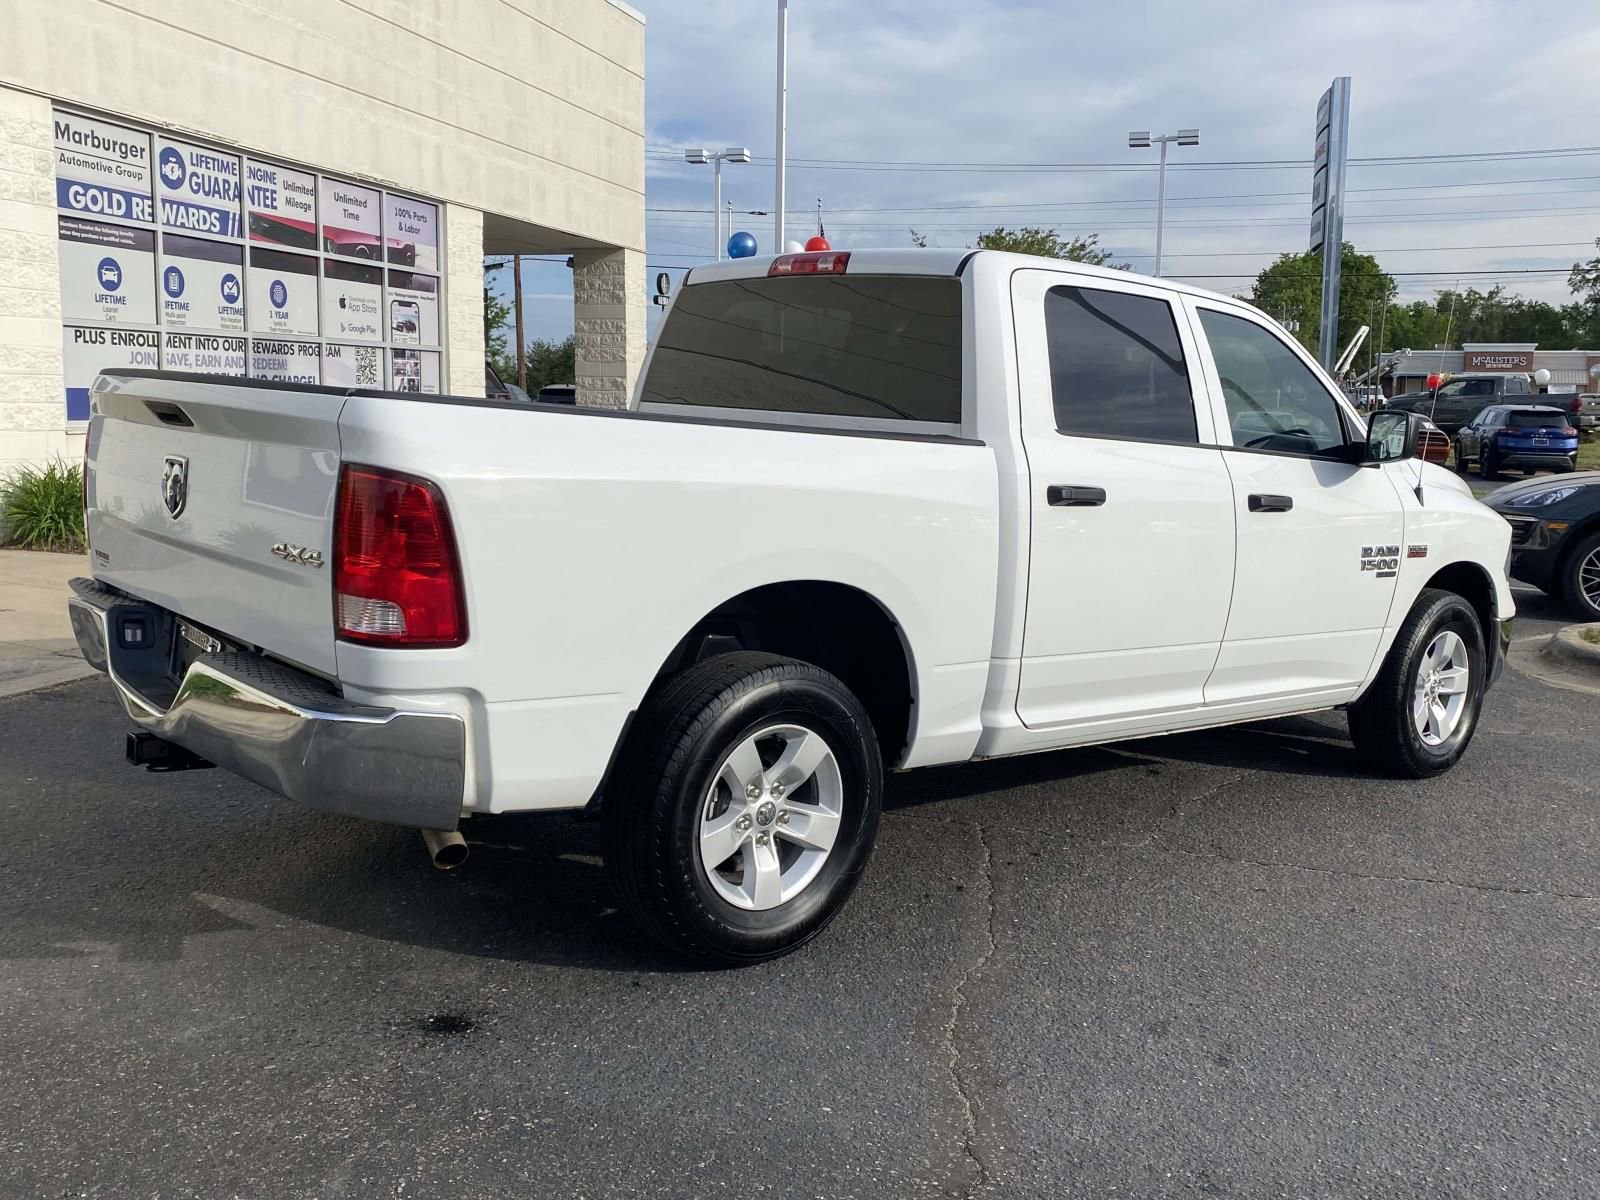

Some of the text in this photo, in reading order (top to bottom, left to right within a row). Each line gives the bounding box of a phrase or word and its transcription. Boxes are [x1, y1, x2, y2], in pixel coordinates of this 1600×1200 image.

[55, 121, 145, 160] Marburger
[59, 152, 143, 181] Automotive Group
[190, 152, 237, 176] LIFETIME
[283, 180, 314, 197] Unlimited
[68, 185, 126, 217] GOLD
[285, 198, 311, 212] Mileage
[334, 192, 367, 209] Unlimited
[343, 209, 360, 221] Time
[395, 207, 427, 223] 100% Parts
[399, 222, 420, 235] & Labor
[95, 293, 126, 305] LIFETIME
[218, 305, 244, 316] LIFETIME
[348, 302, 377, 314] App Store
[275, 311, 289, 320] YEAR
[348, 323, 376, 335] Google Play
[75, 330, 105, 345] PLUS
[195, 337, 219, 351] INTO
[222, 339, 244, 353] OUR
[195, 354, 221, 368] EARN
[224, 355, 244, 369] AND
[1361, 545, 1399, 558] RAM
[1360, 558, 1398, 571] 1500
